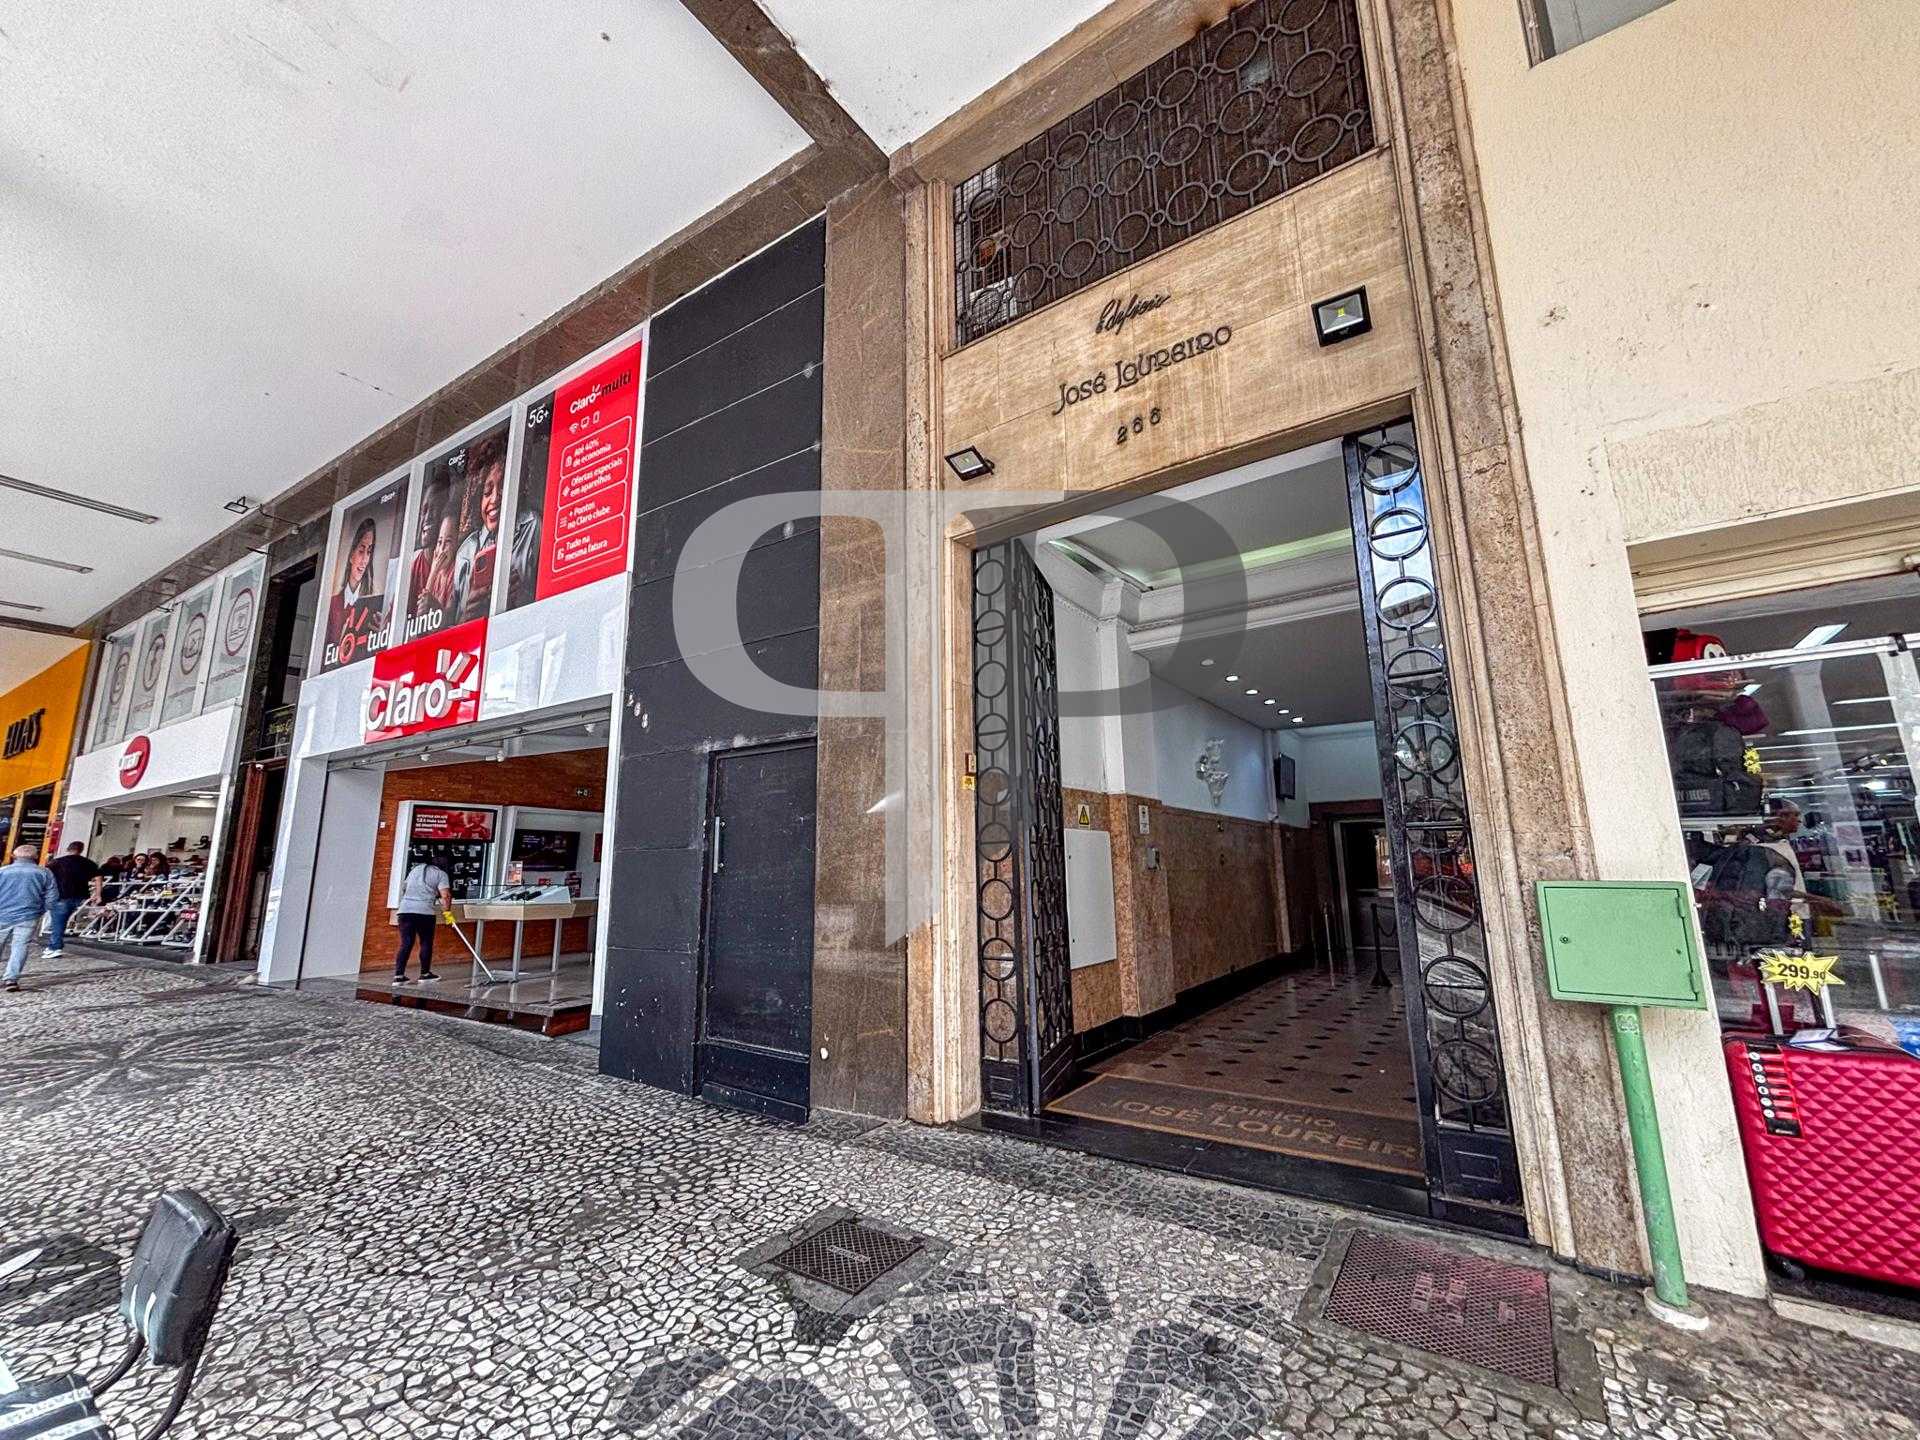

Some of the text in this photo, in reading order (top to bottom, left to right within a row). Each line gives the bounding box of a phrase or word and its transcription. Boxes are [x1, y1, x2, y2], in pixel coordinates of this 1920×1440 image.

[569, 370, 632, 414] Claro multi
[1116, 407, 1162, 445] 266
[324, 608, 442, 666] Eu tud junto
[365, 677, 448, 731] Claro
[1209, 1114, 1425, 1161] LOUREIR
